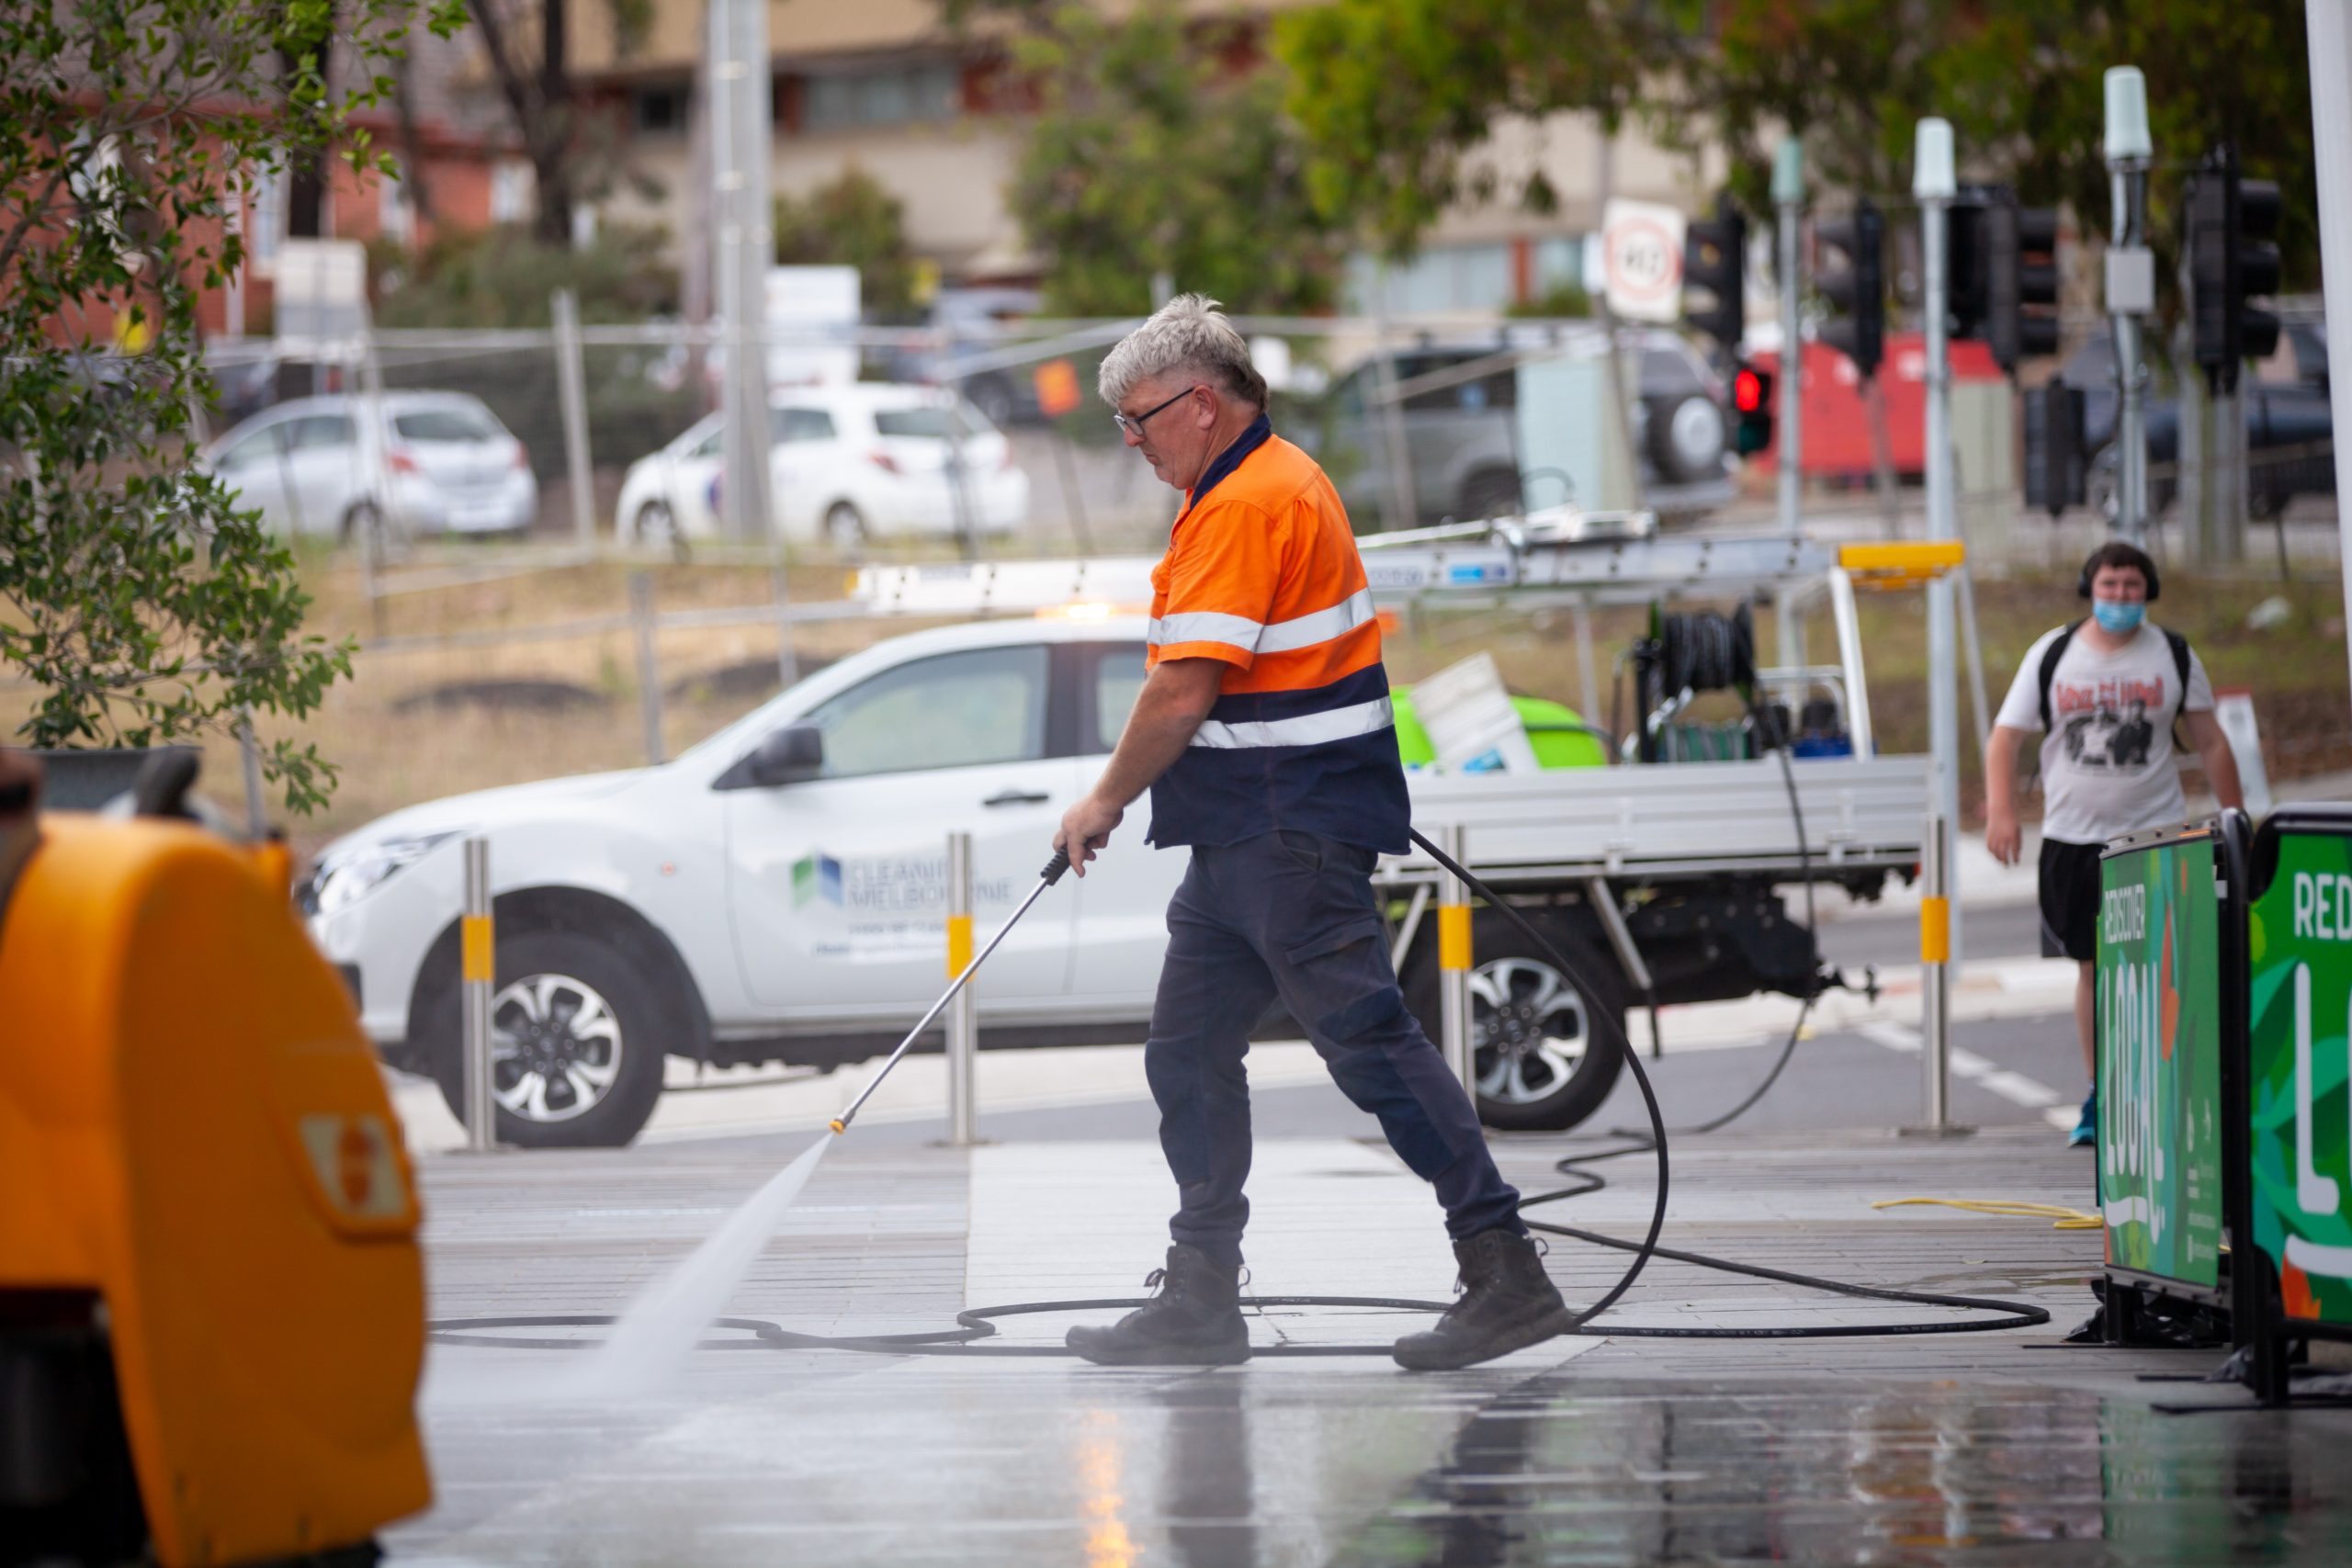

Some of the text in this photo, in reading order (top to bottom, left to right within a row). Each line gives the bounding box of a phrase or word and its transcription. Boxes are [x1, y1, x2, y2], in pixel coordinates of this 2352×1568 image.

[849, 859, 979, 882] CLEANI
[2294, 872, 2352, 941] RED
[2104, 961, 2165, 1246] LOCAL
